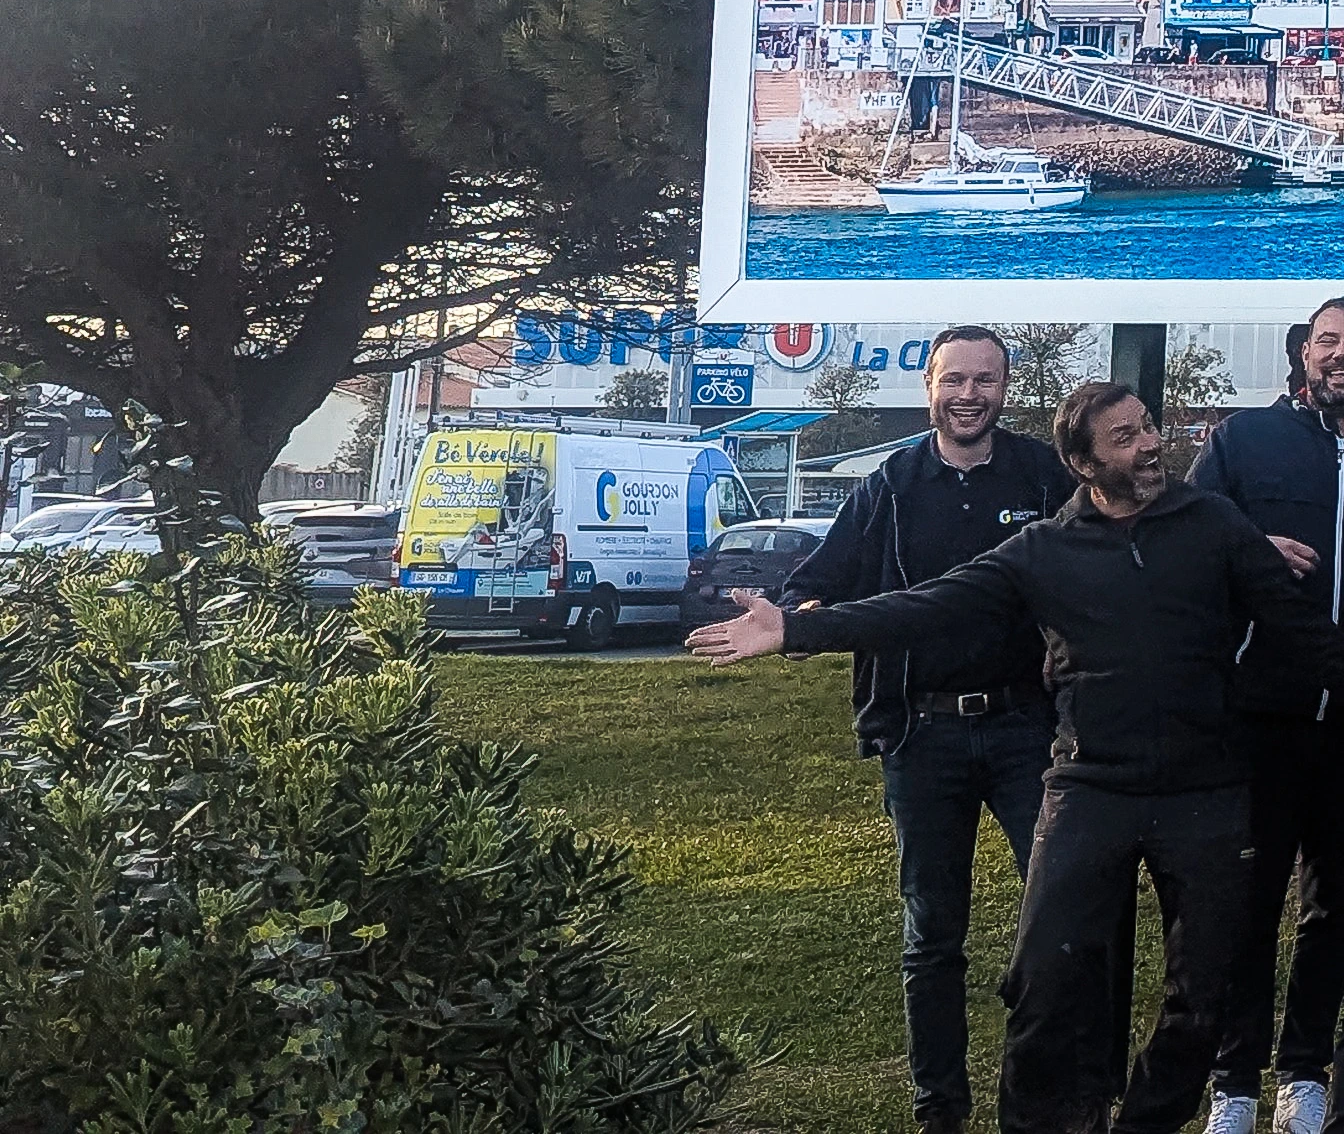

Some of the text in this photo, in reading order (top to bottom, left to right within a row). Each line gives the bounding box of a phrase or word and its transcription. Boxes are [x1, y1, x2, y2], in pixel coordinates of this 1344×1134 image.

[852, 341, 889, 372] La
[622, 482, 679, 499] GOURDON
[622, 500, 660, 516] JOLLY
